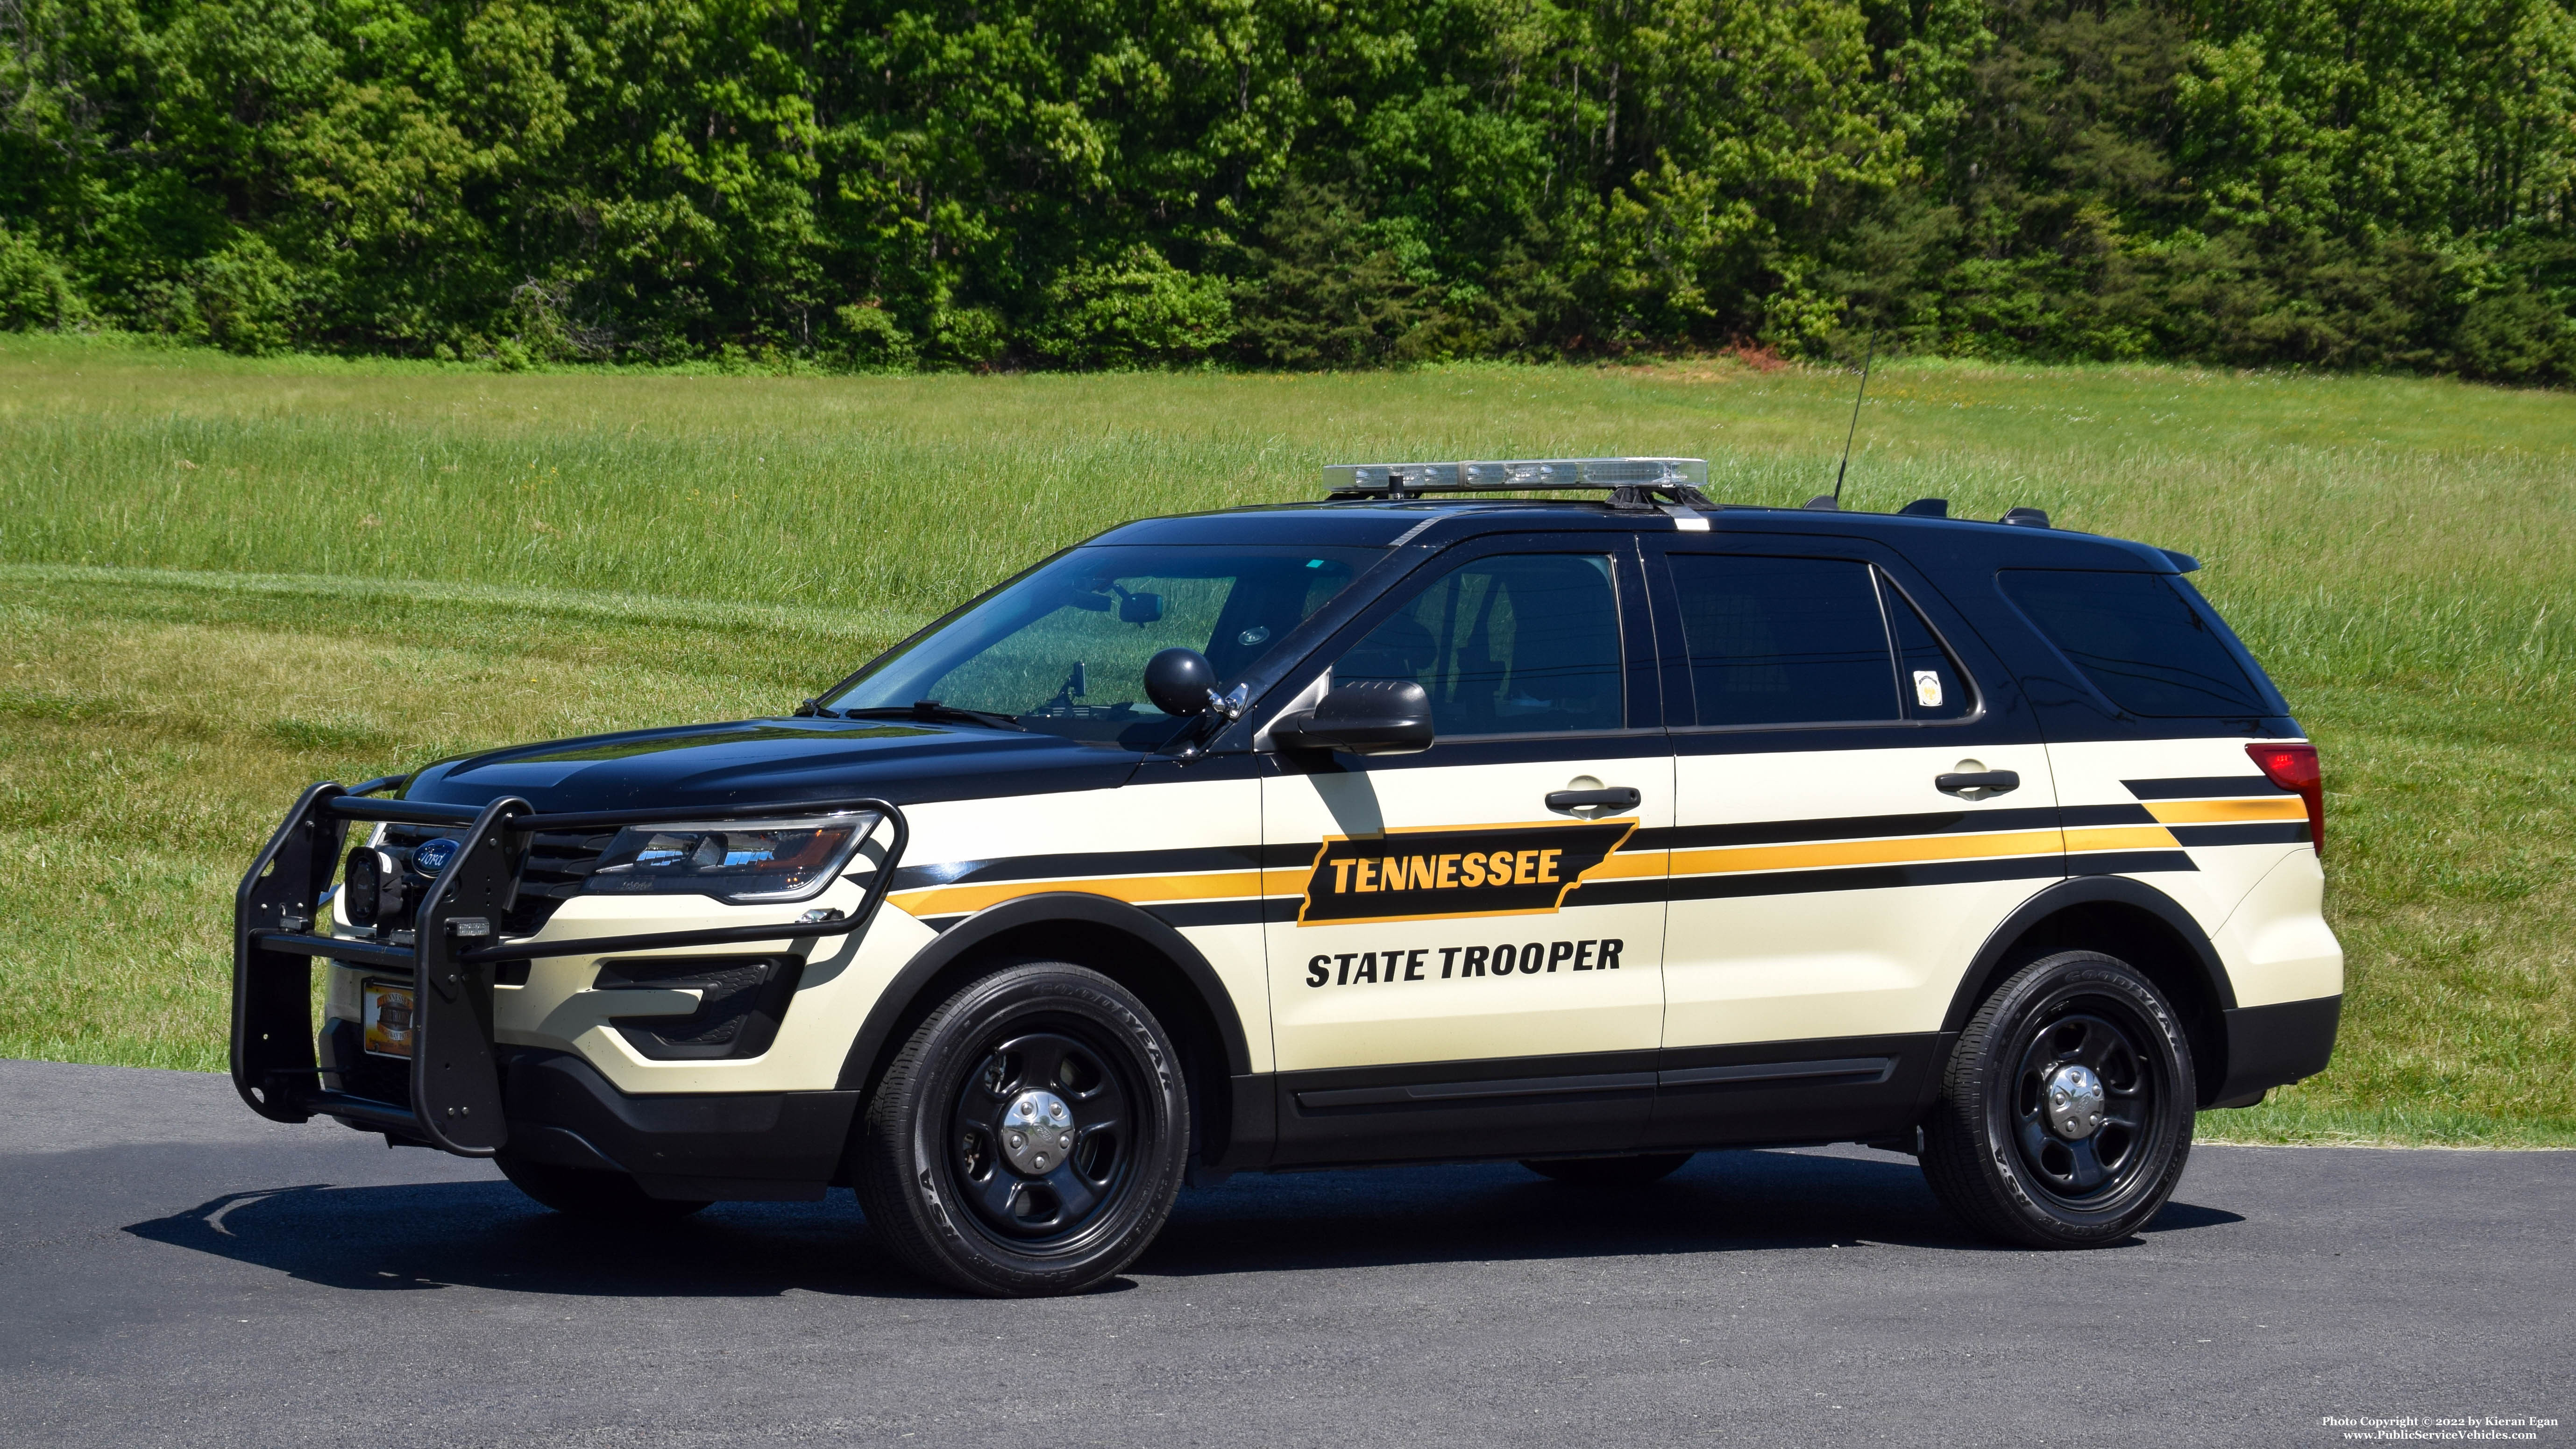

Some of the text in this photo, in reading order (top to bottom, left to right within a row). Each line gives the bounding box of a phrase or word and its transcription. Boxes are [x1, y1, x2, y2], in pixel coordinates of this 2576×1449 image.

[419, 845, 446, 867] Ford
[1330, 849, 1562, 894] TENNESSEE
[1306, 939, 1624, 987] STATE TROOPER
